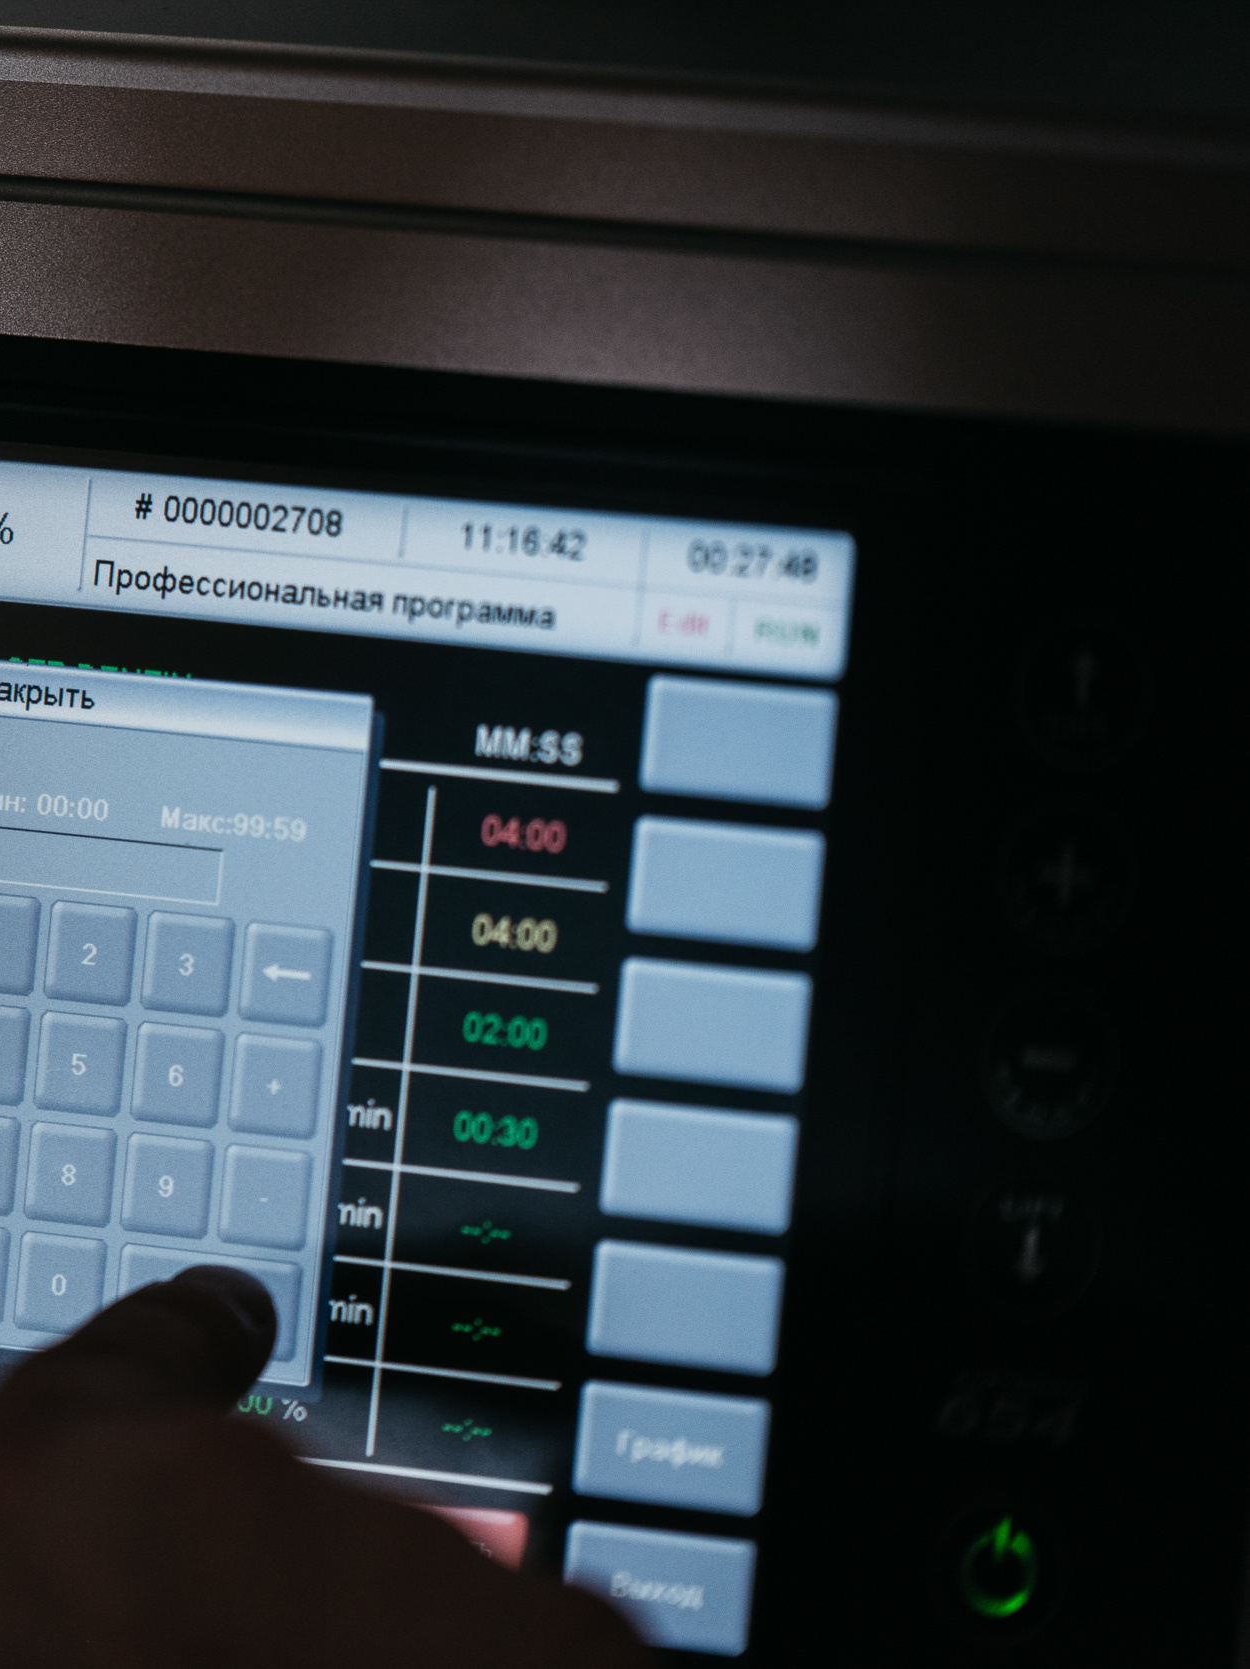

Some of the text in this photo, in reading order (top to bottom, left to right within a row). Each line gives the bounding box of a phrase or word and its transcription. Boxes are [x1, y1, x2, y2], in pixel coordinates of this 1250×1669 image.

[135, 492, 343, 536] # 0000002708
[461, 521, 587, 562] 11:16:42
[94, 559, 556, 632] Профессиональная программа
[474, 722, 585, 767] MM:SS
[37, 792, 110, 822] 00:00
[480, 813, 568, 855] 04:00
[471, 912, 559, 954] 04:00
[81, 942, 98, 967] 2
[177, 952, 195, 977] 3
[462, 1011, 549, 1051] 02:00
[70, 1052, 88, 1077] 5
[167, 1063, 185, 1088] 6
[453, 1110, 539, 1149] 00:30
[60, 1163, 78, 1187] 8
[158, 1174, 175, 1198] 9
[51, 1273, 68, 1296] 0
